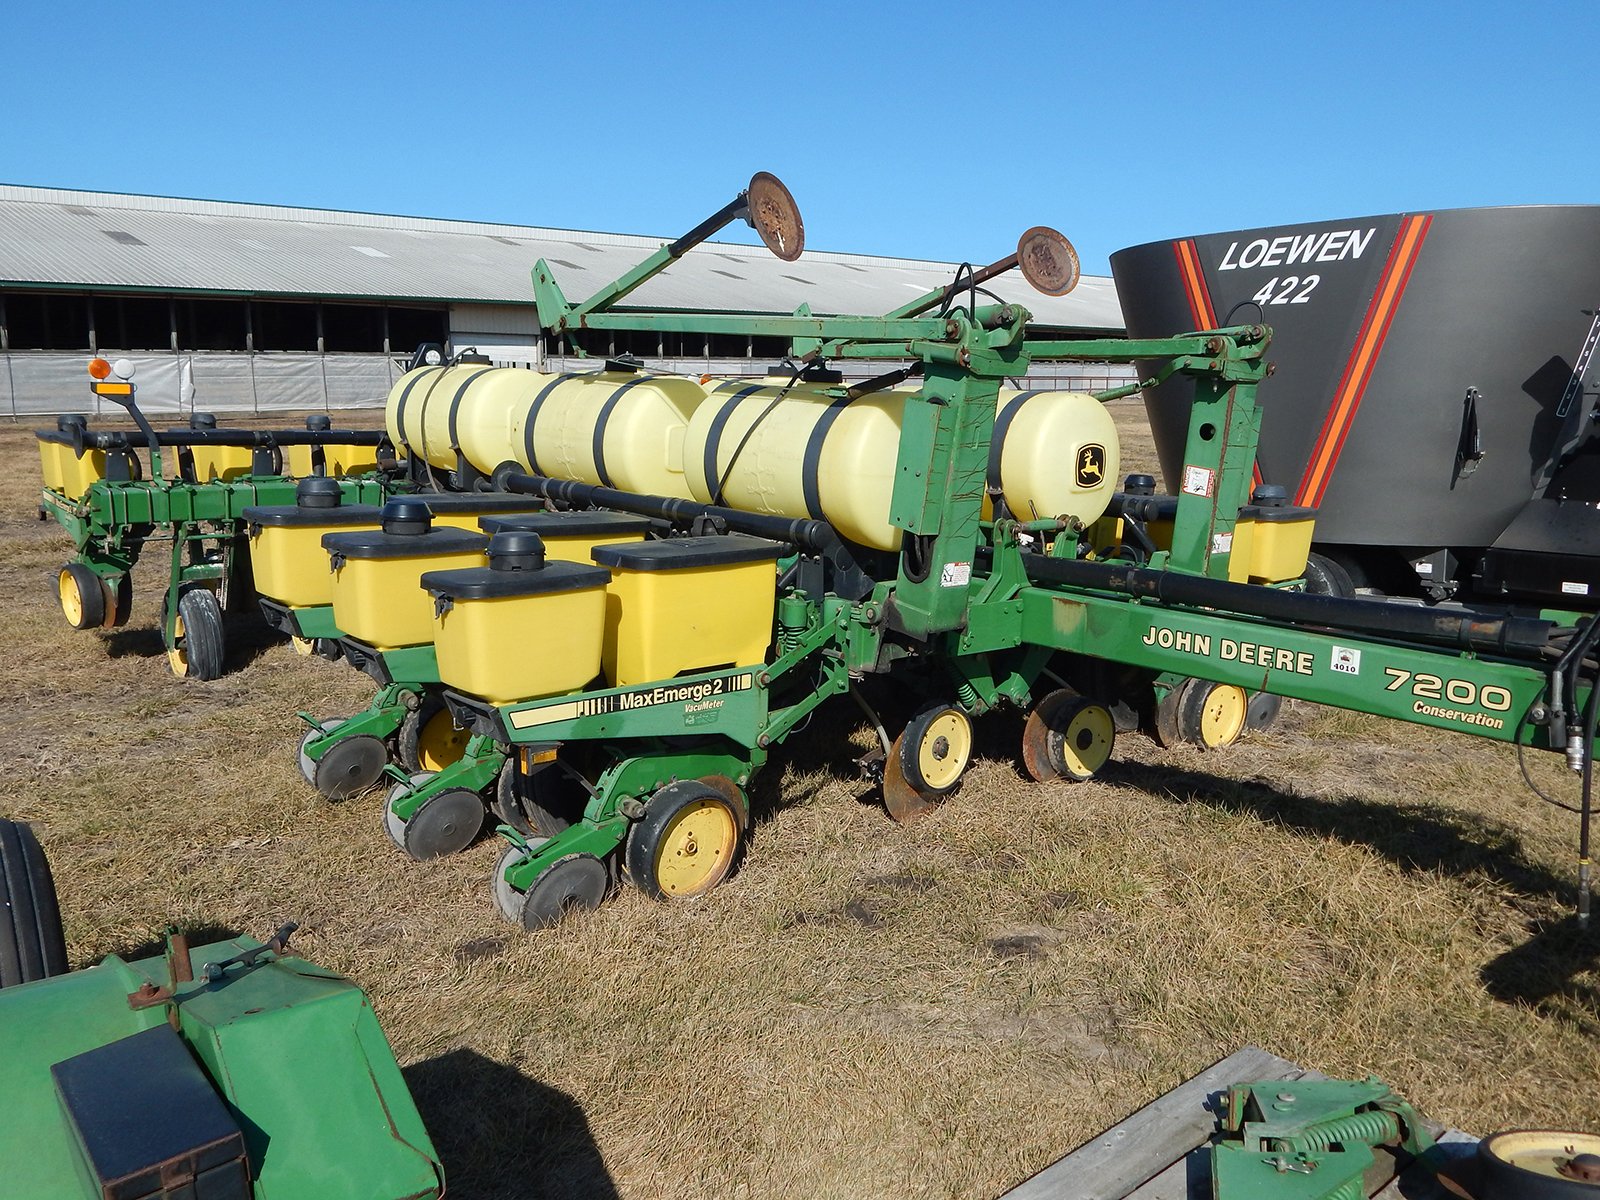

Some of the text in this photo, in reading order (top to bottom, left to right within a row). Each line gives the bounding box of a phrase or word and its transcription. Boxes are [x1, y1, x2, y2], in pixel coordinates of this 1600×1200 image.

[1218, 228, 1376, 271] LOEWEN
[1252, 274, 1320, 306] 422
[1142, 626, 1314, 676] JOHN DEERE
[1333, 663, 1356, 673] 4010
[1384, 667, 1512, 712] 7200
[685, 700, 725, 713] VacuMeter
[1412, 700, 1504, 729] Conservation
